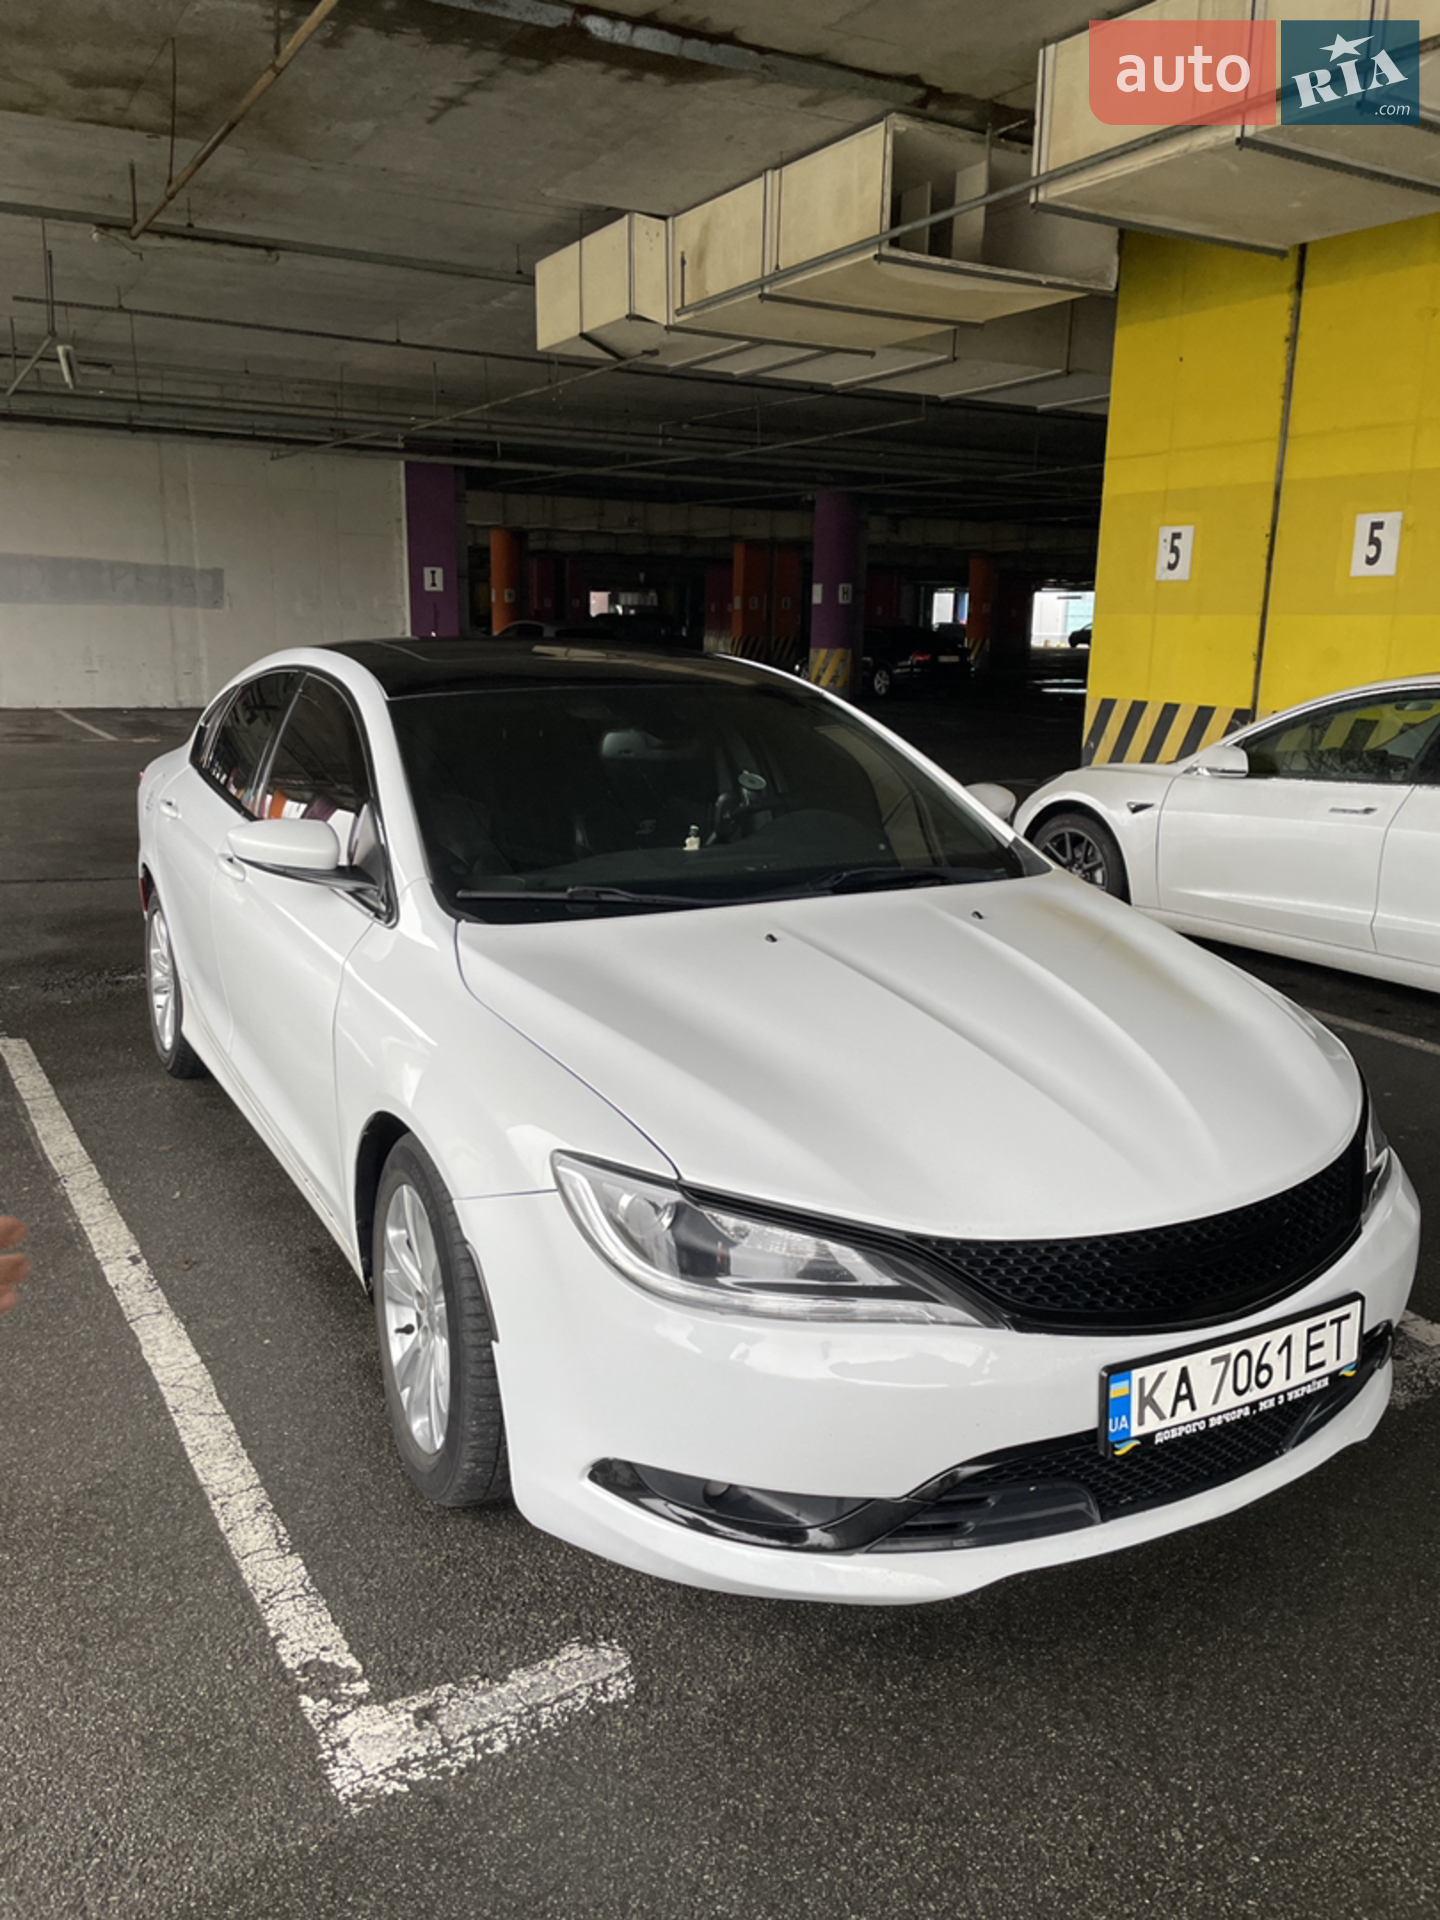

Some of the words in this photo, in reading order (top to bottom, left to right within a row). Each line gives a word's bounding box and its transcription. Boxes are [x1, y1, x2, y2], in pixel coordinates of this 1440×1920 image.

[1167, 532, 1182, 571] 5
[1364, 520, 1385, 566] 5
[842, 586, 850, 601] H
[1137, 1365, 1197, 1427] KA
[1210, 1334, 1293, 1406] 7061
[1305, 1313, 1352, 1373] ET
[1109, 1415, 1129, 1433] UA
